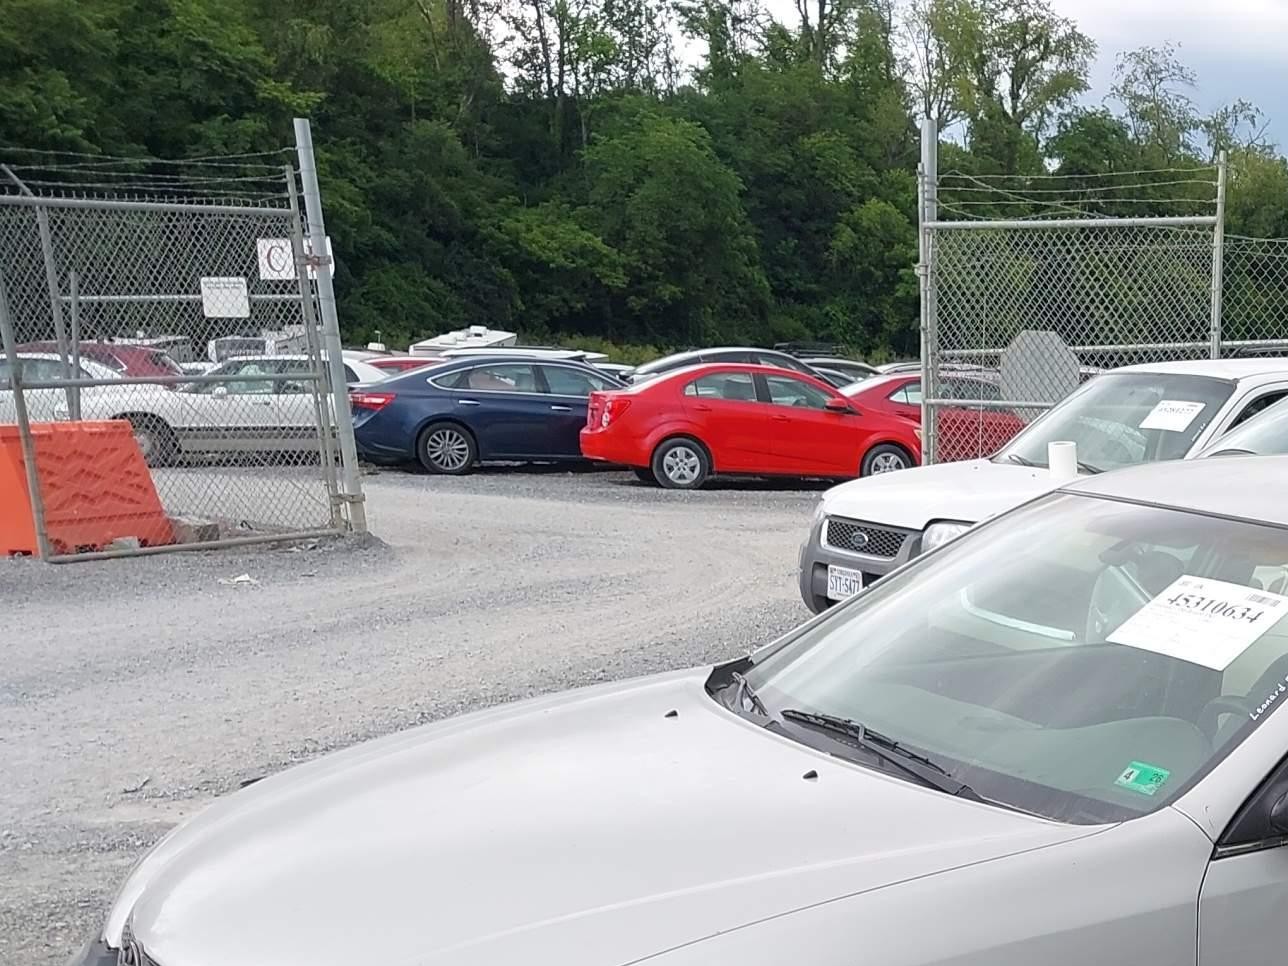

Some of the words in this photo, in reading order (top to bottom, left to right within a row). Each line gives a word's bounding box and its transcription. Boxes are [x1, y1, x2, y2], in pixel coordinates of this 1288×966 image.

[1167, 592, 1265, 624] 45310634
[1249, 682, 1287, 721] Leonard
[1123, 770, 1135, 780] 4
